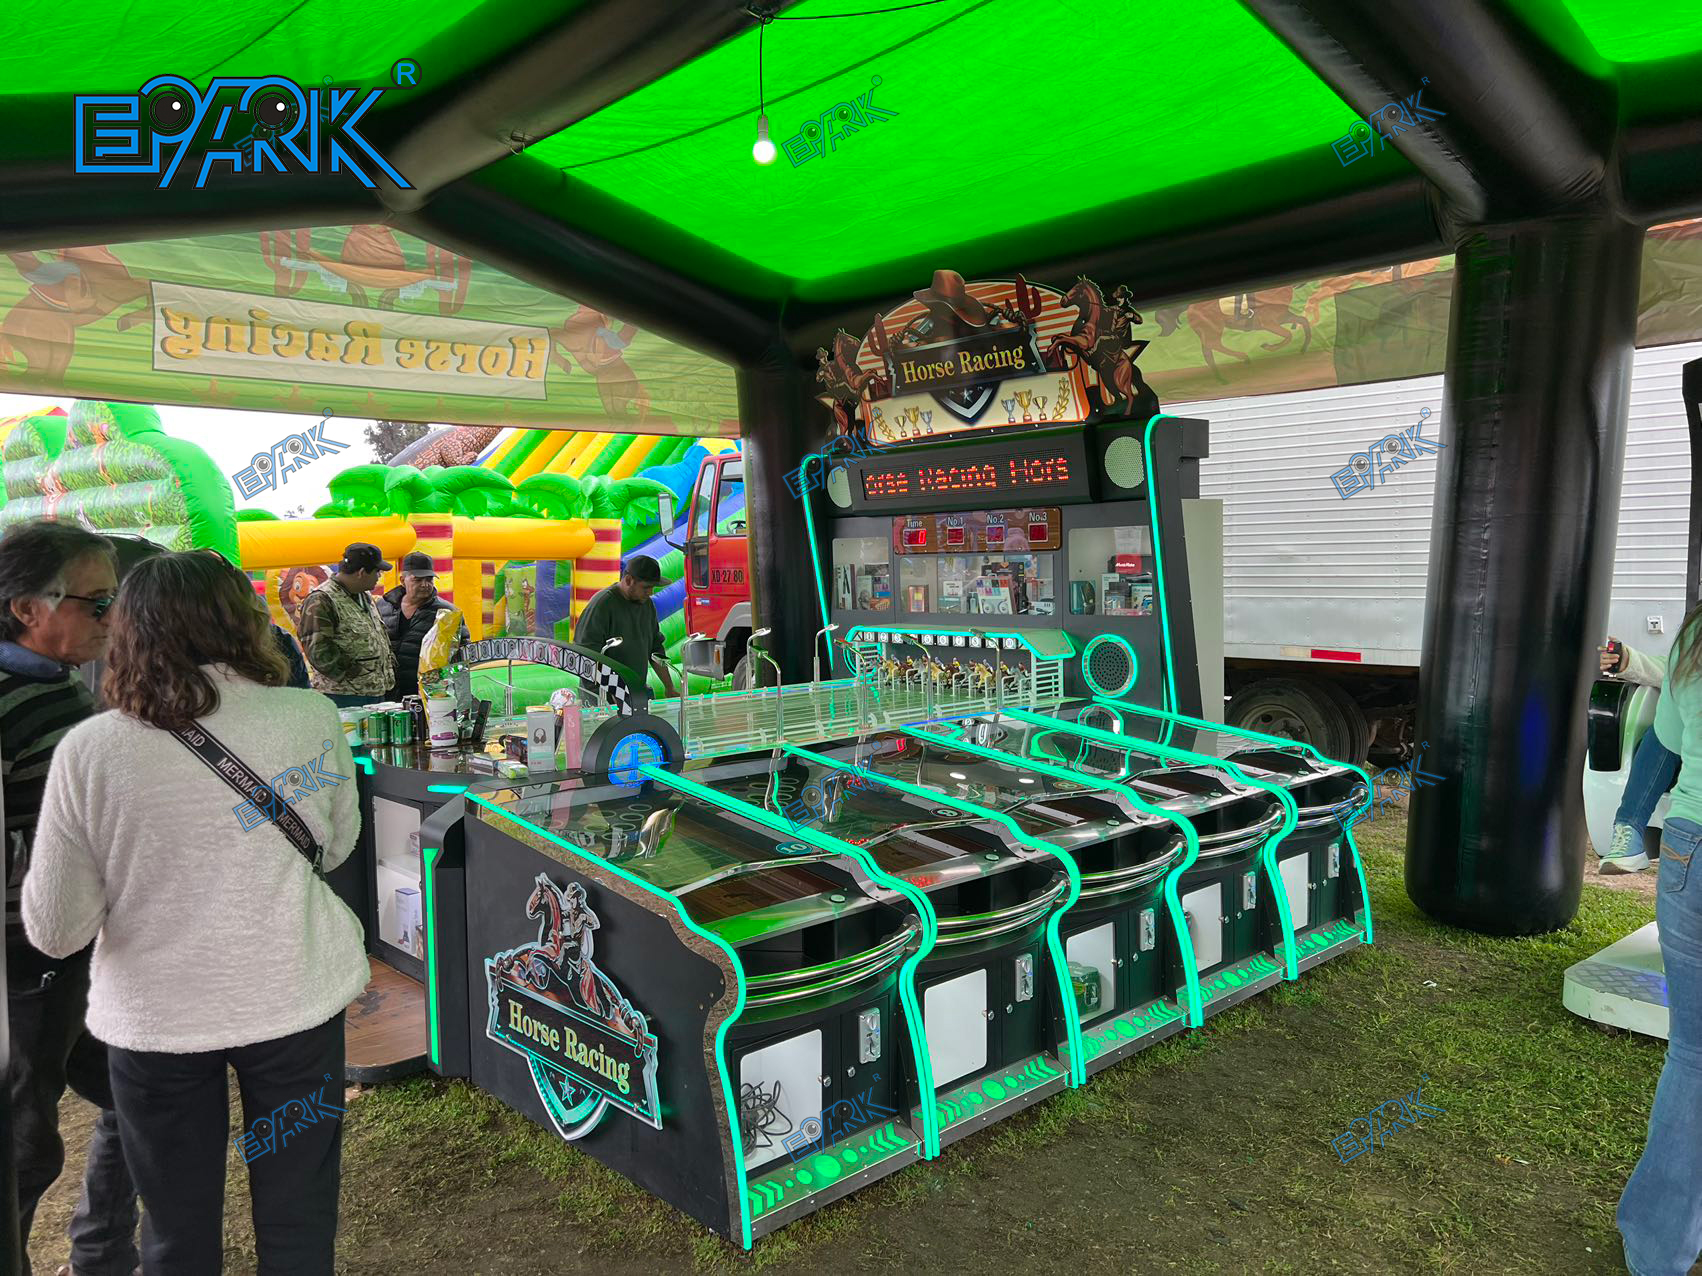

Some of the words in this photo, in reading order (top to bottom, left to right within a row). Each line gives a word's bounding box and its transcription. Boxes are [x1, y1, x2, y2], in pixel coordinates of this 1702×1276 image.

[901, 360, 955, 384] Horse
[958, 345, 1025, 373] Racing
[906, 519, 923, 528] Time
[947, 516, 964, 525] No.1
[987, 514, 1004, 524] No.2
[1028, 512, 1048, 522] No.3
[217, 757, 268, 803] MERMAID
[277, 812, 311, 850] MERMAID
[508, 999, 561, 1051] Horse
[564, 1026, 630, 1095] Racing
